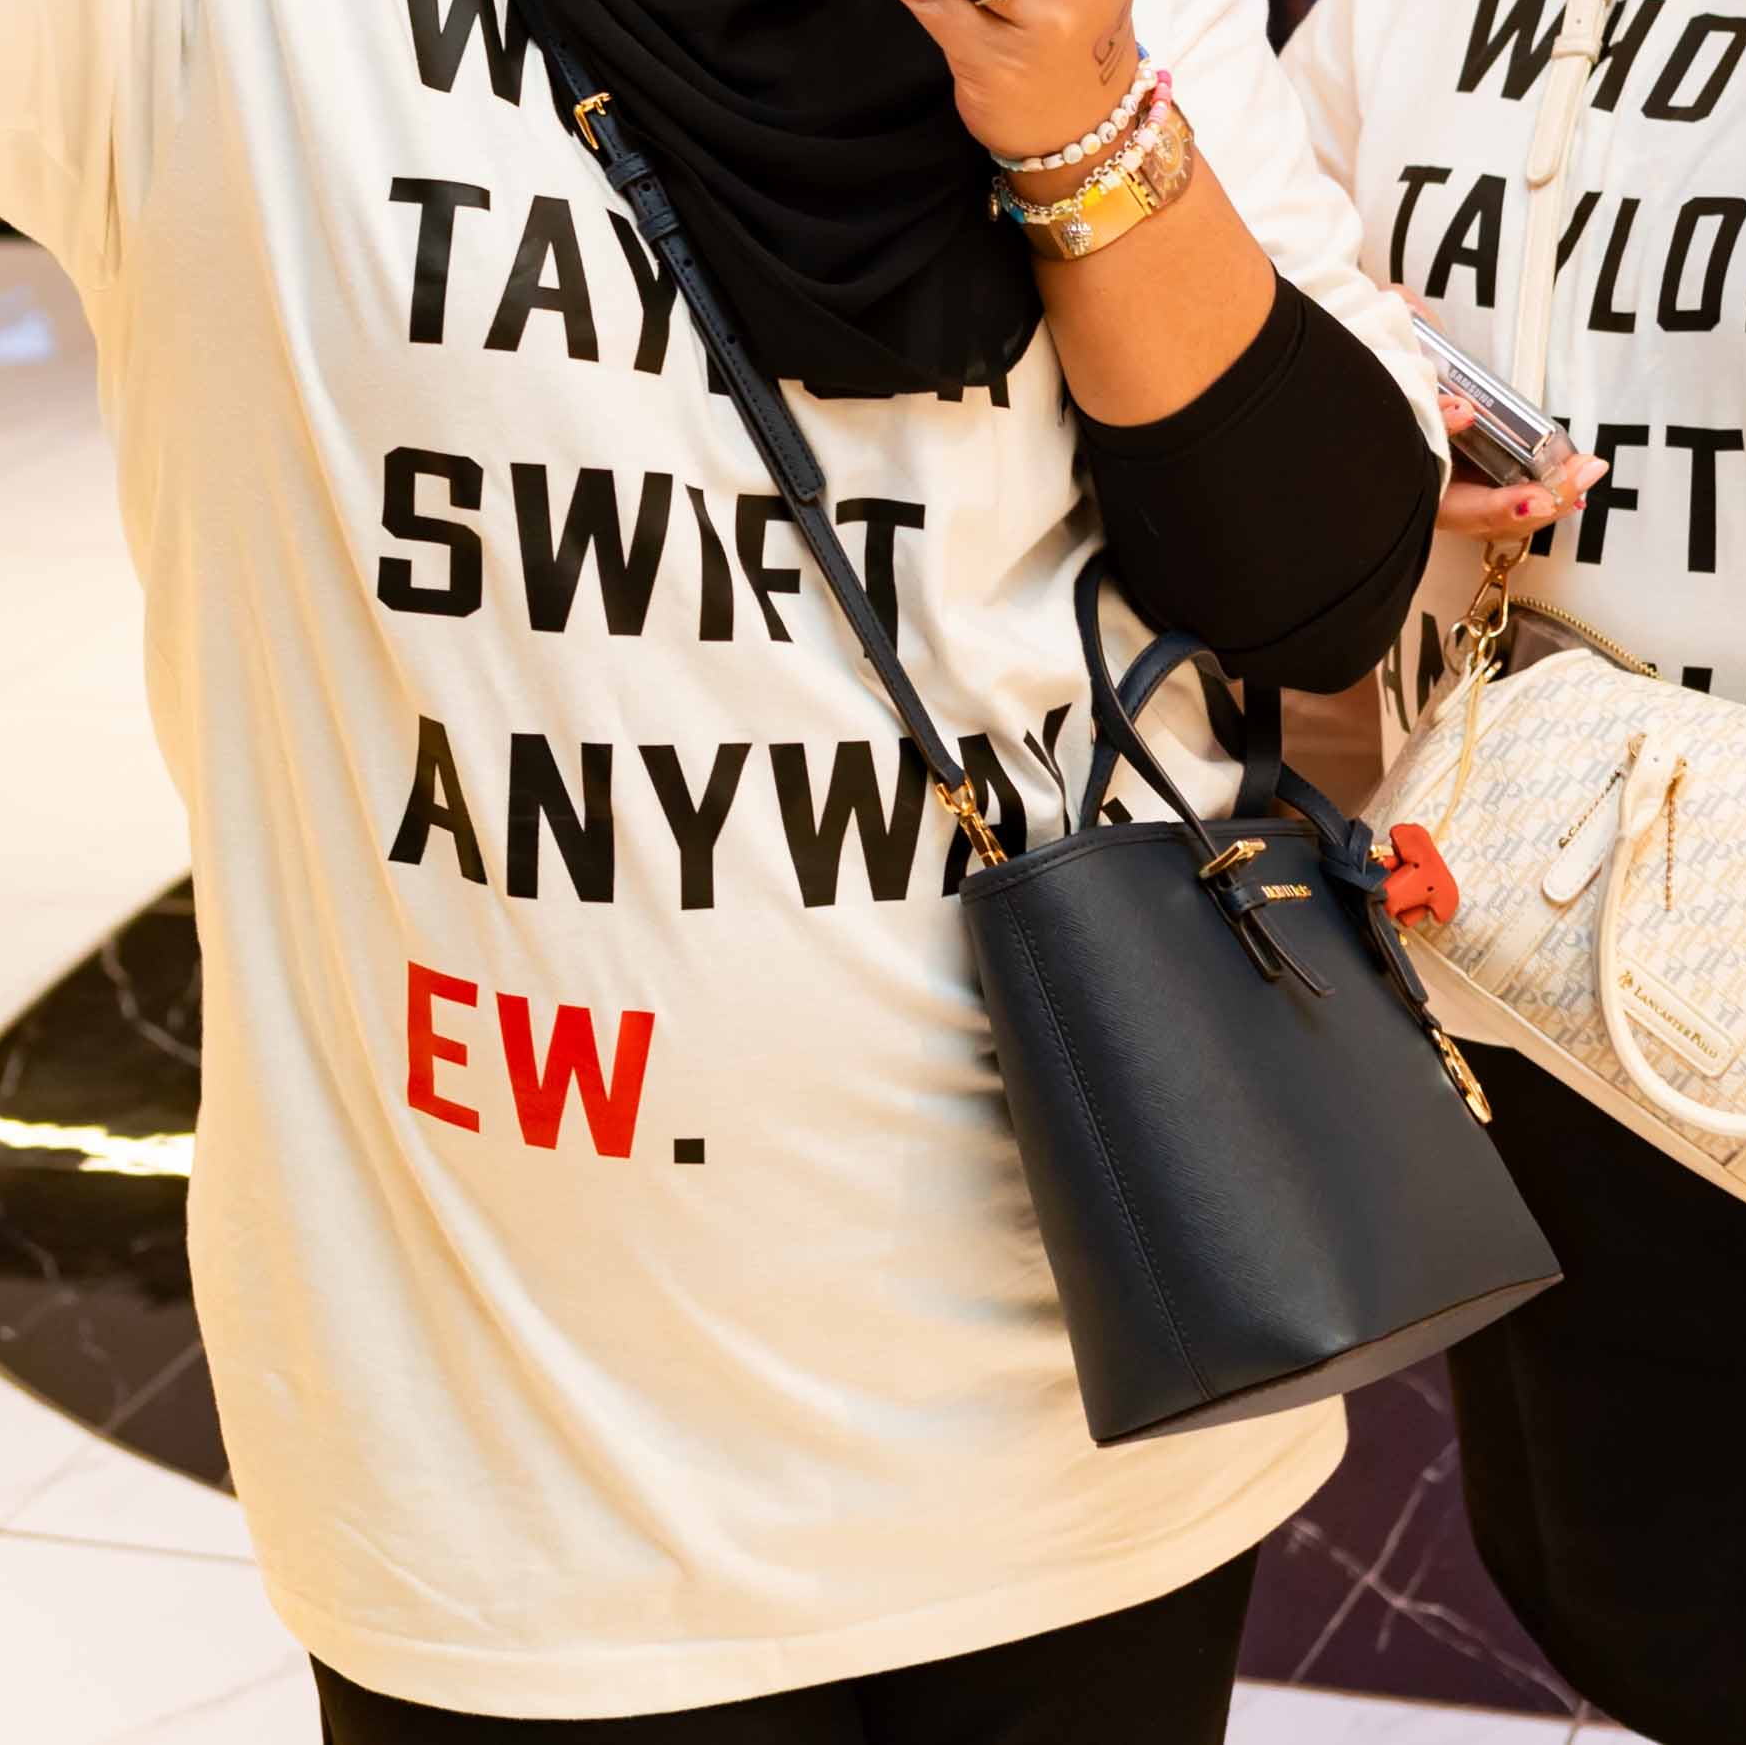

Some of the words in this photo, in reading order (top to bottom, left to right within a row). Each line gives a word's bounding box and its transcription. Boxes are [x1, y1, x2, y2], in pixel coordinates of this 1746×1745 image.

[389, 176, 1011, 410] TAY
[1448, 366, 1495, 410] SAMSUNG
[377, 446, 926, 658] SWIFT
[407, 960, 706, 1166] EW.
